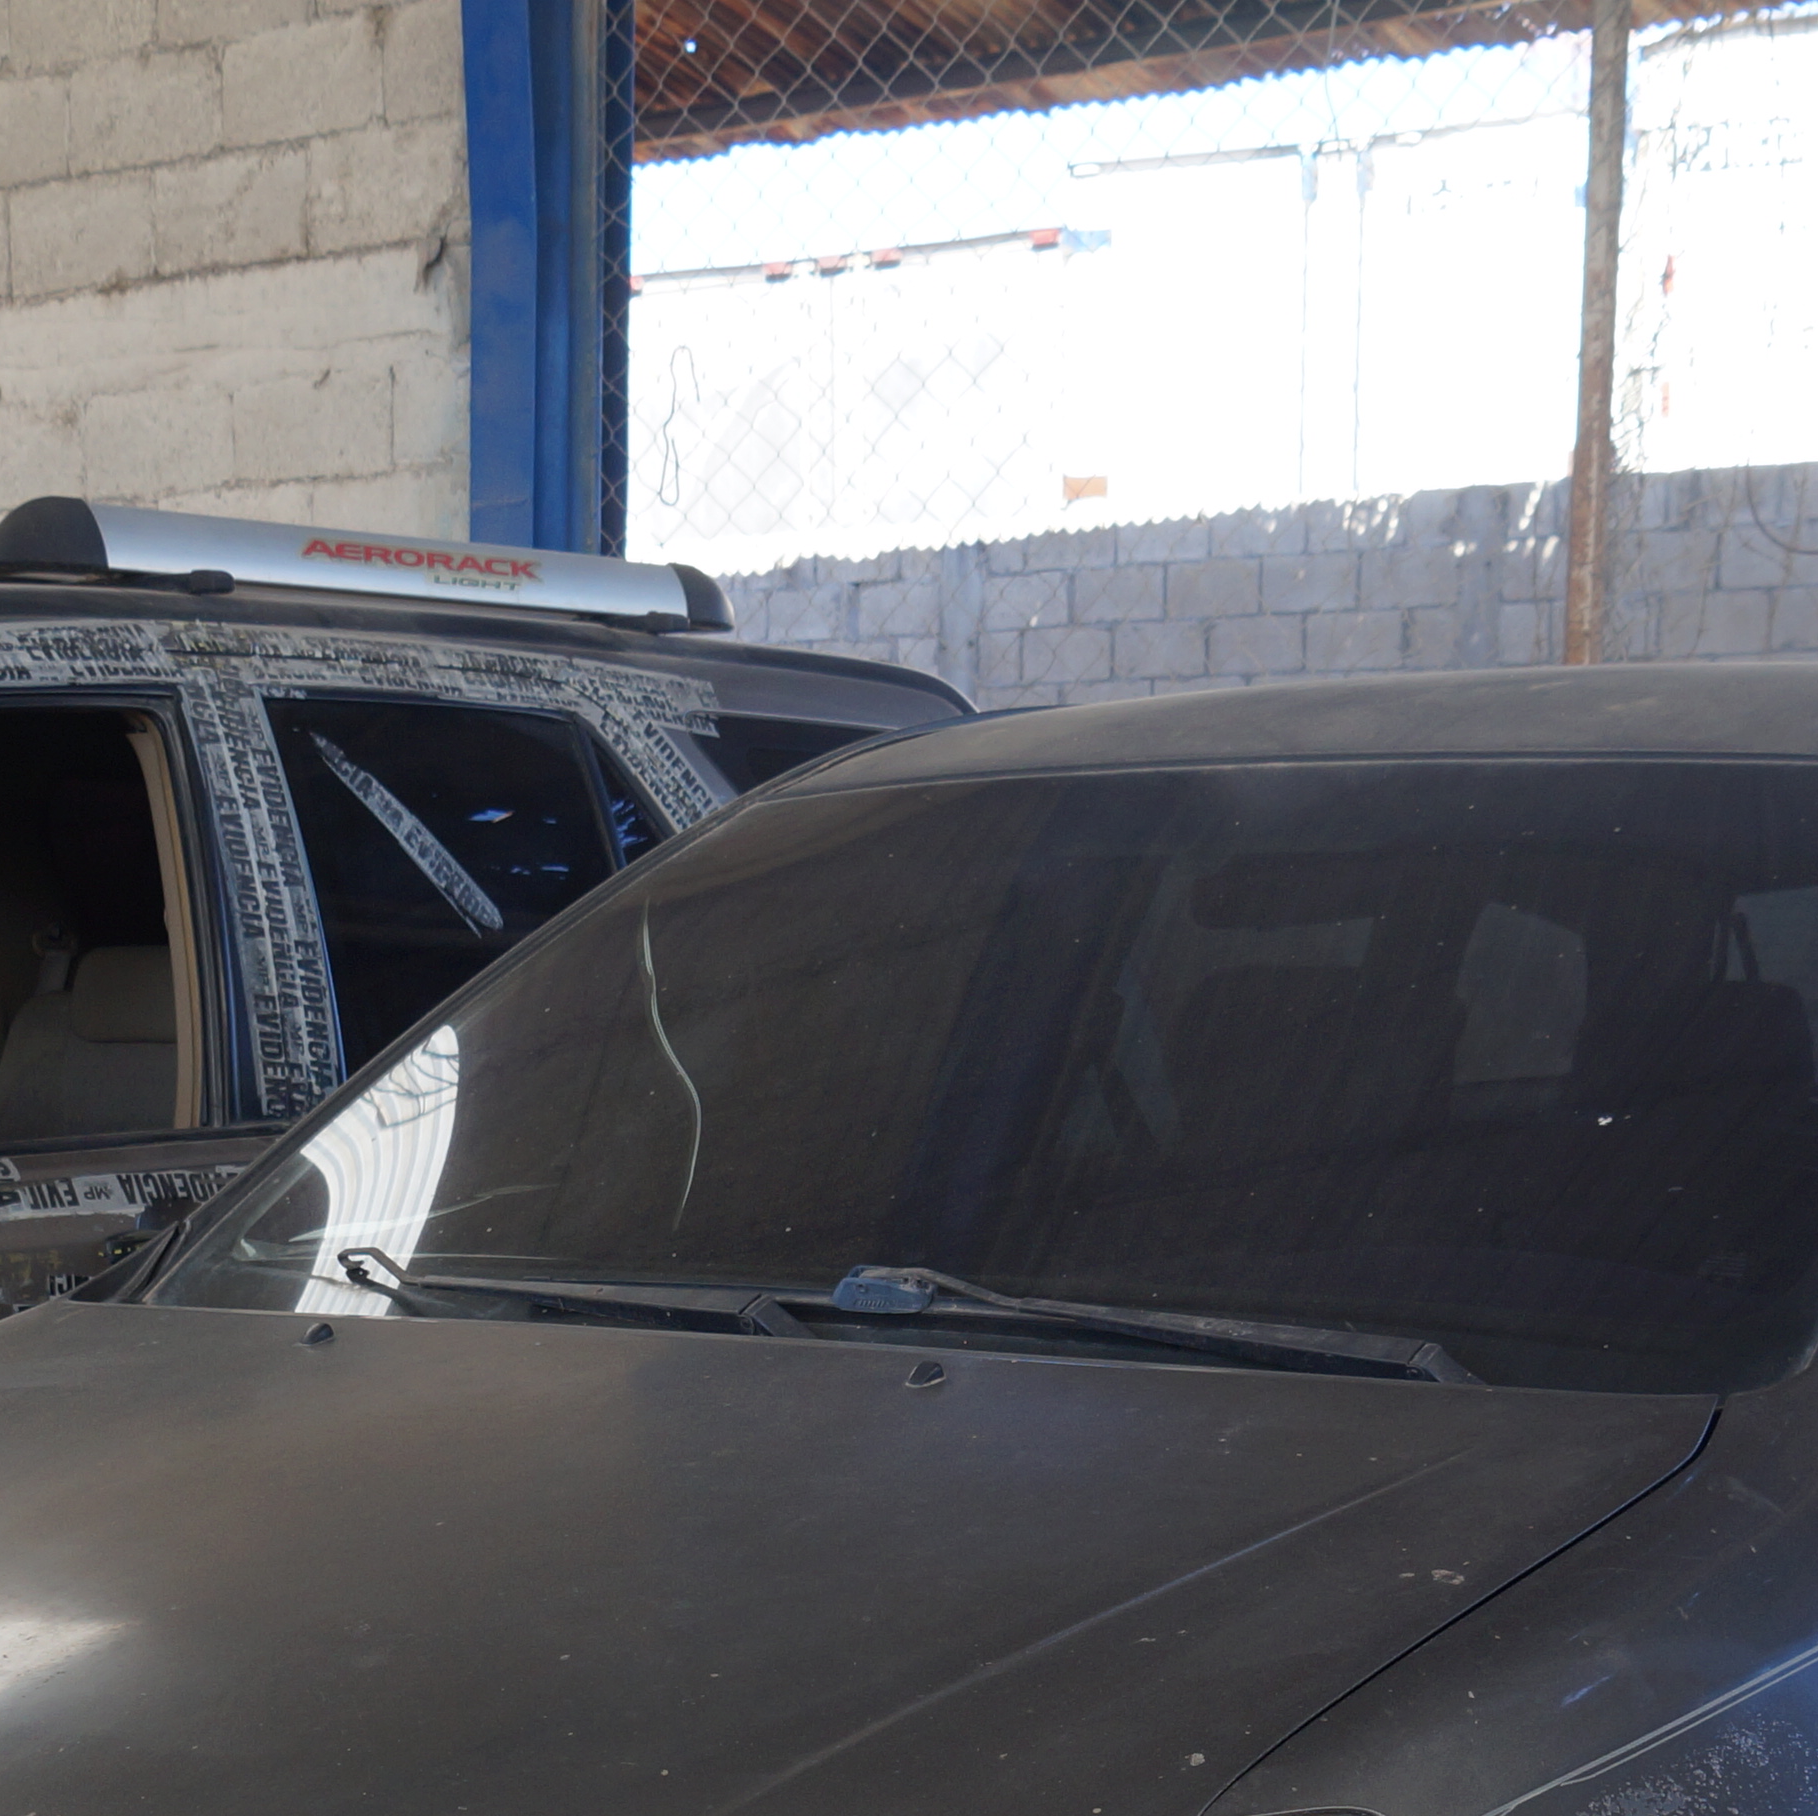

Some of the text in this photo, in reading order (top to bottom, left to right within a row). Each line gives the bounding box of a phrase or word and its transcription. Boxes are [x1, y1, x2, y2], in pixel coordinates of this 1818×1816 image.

[302, 539, 541, 579] AERORACK
[433, 574, 521, 592] LIGHT
[215, 797, 265, 939] EVIDENCIA
[250, 747, 304, 889] EVIDENCIA
[295, 940, 335, 1089] EVIDENCIA
[257, 862, 300, 1008] EVIDENCIA
[83, 1184, 111, 1200] MP
